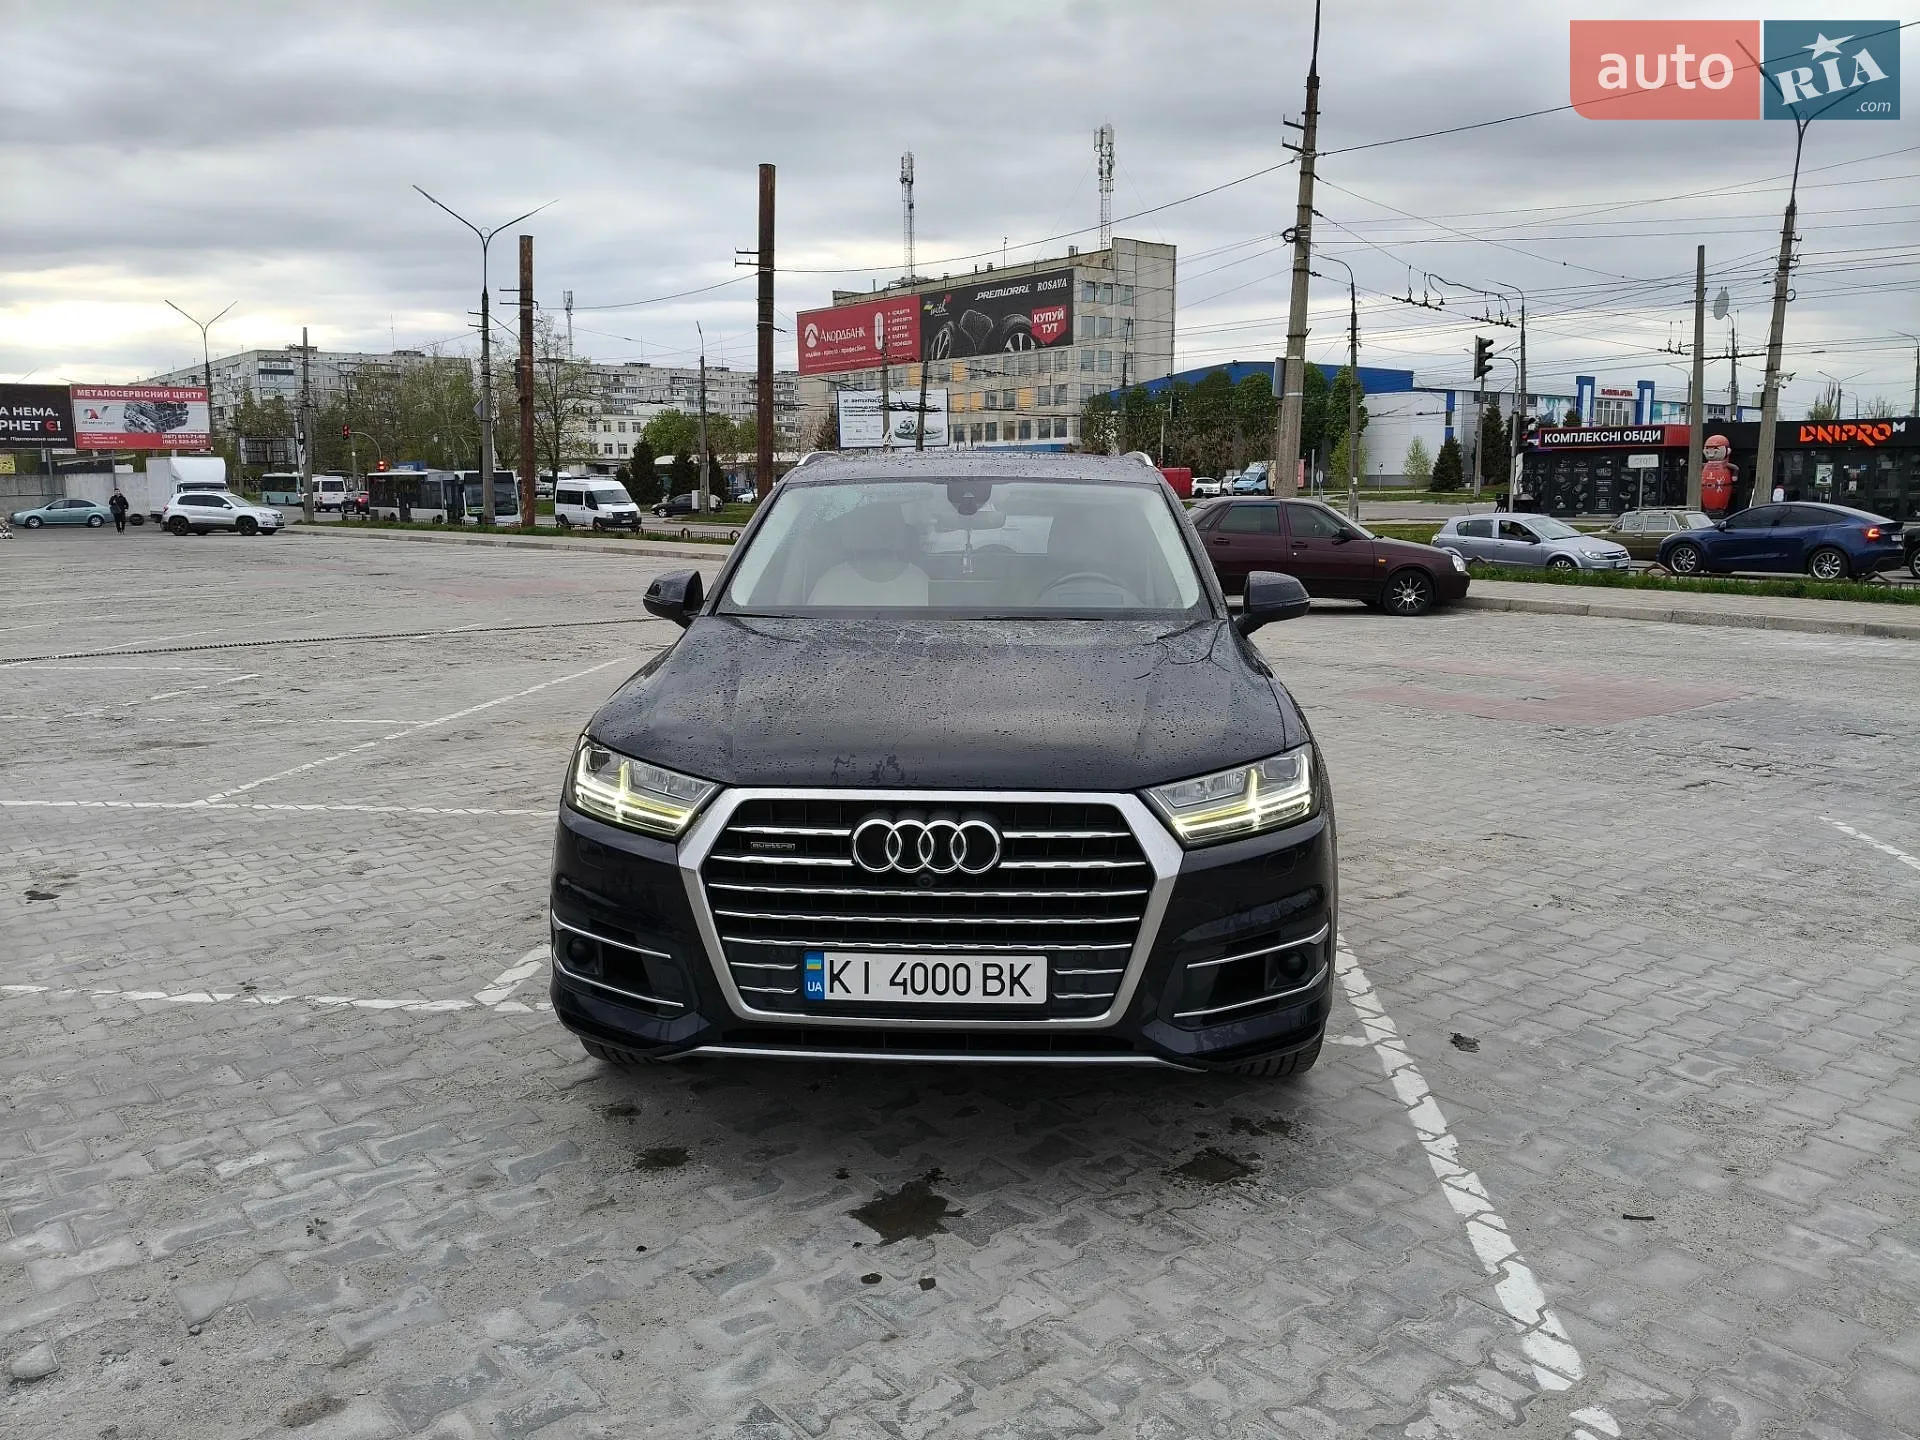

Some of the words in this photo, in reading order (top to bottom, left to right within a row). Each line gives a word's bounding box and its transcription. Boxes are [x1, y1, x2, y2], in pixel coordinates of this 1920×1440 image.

[1036, 277, 1068, 293] ROSAVA
[1033, 307, 1065, 324] КУПУЙ
[1041, 322, 1058, 335] ТУТ
[76, 389, 171, 399] МЕТАЛОСЕРВІСНИЙ
[172, 391, 204, 400] ЦЕНТР
[12, 406, 59, 417] НЕМА.
[45, 420, 62, 431] Є!
[1544, 431, 1621, 444] КОМПЛЕКСНІ
[1623, 429, 1661, 443] ОБІДИ
[1800, 423, 1892, 447] DNIPRO
[889, 961, 971, 996] 4000
[982, 963, 1032, 997] BK
[807, 981, 823, 992] UA
